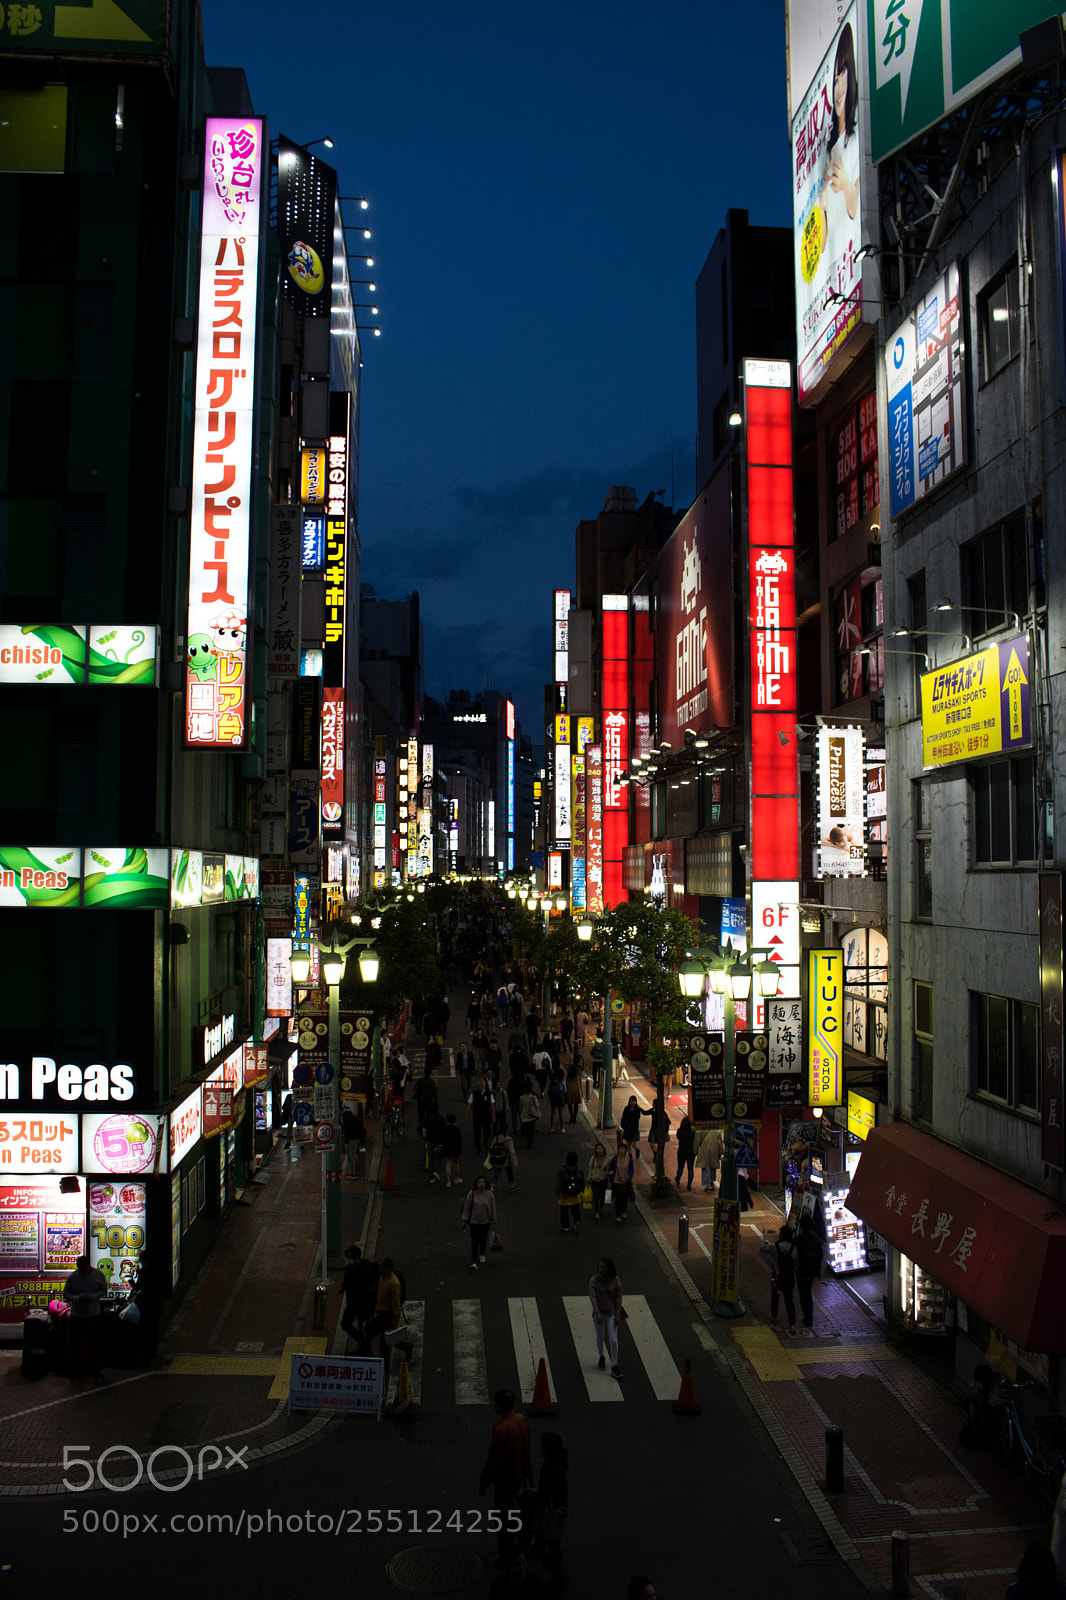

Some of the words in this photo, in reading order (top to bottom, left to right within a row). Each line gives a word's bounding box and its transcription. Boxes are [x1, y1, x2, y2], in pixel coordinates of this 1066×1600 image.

[0, 4, 42, 37] 秒
[795, 74, 831, 177] 高収入
[227, 129, 255, 203] 珍台さん
[748, 363, 785, 372] ワールド
[303, 520, 316, 559] カラオケ
[756, 576, 764, 627] TAITO
[677, 606, 707, 700] GAME
[765, 577, 789, 705] GAME
[1, 646, 61, 664] chislo
[932, 659, 985, 702] ムラサキスポーツ
[1008, 667, 1021, 684] GO!
[932, 696, 961, 714] MURASAKI
[962, 688, 986, 705] SPORTS
[830, 746, 842, 811] Princess
[850, 845, 863, 859] 3F
[0, 871, 14, 887] n
[22, 868, 67, 887] Peas
[762, 907, 789, 927] 6F
[32, 1057, 134, 1101] Peas
[319, 1127, 331, 1139] 30
[21, 1147, 62, 1163] Peas
[91, 1225, 144, 1249] 100
[315, 1366, 377, 1381] 車両通行止
